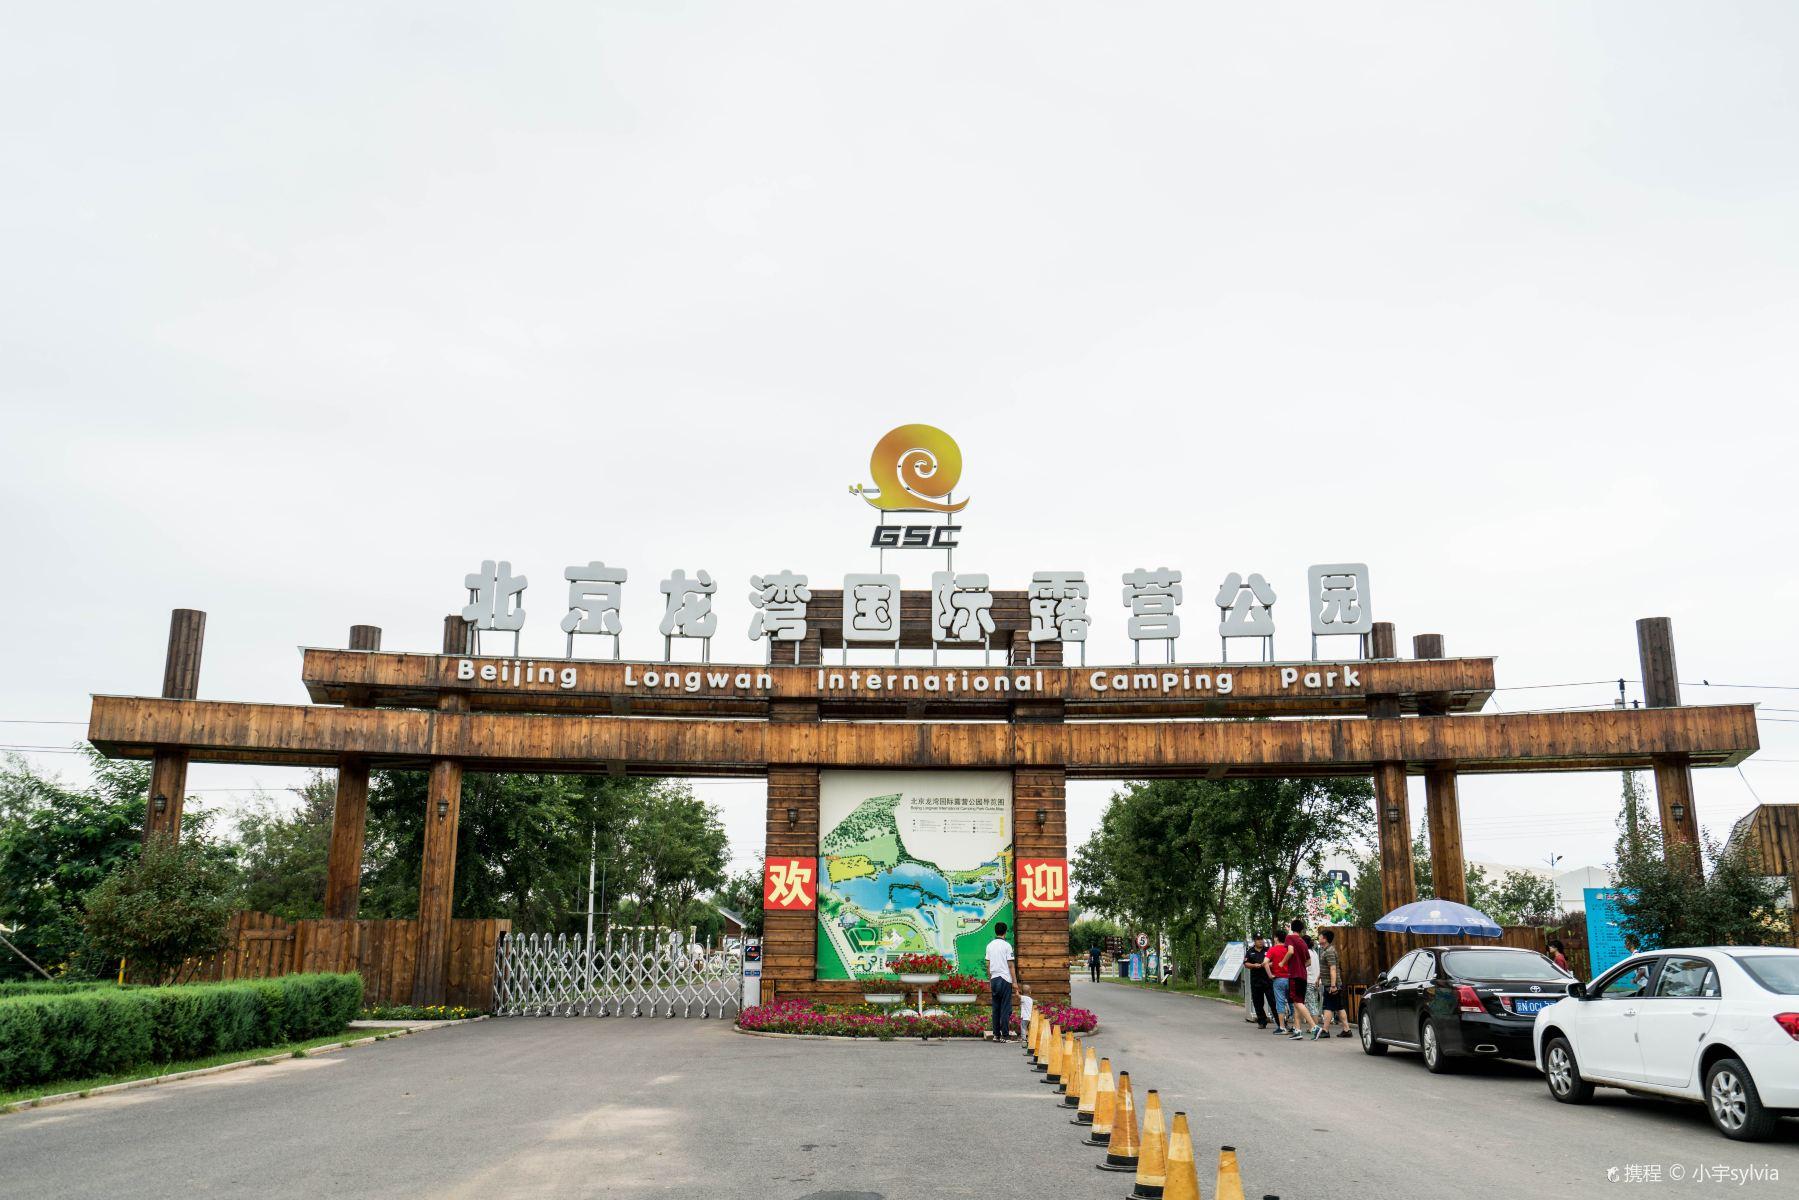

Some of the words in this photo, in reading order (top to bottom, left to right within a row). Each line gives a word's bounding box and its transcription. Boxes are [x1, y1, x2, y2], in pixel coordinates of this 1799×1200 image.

[870, 524, 962, 549] GSC
[462, 560, 1373, 643] 北京龙湾国际露营公园
[456, 660, 578, 690] Beijing
[624, 665, 773, 692] Longwan
[817, 669, 1044, 692] International
[1089, 668, 1234, 695] Camping
[1280, 666, 1362, 688] Park
[767, 860, 813, 908] 欢
[1020, 863, 1066, 909] 迎
[1139, 936, 1146, 946] 5
